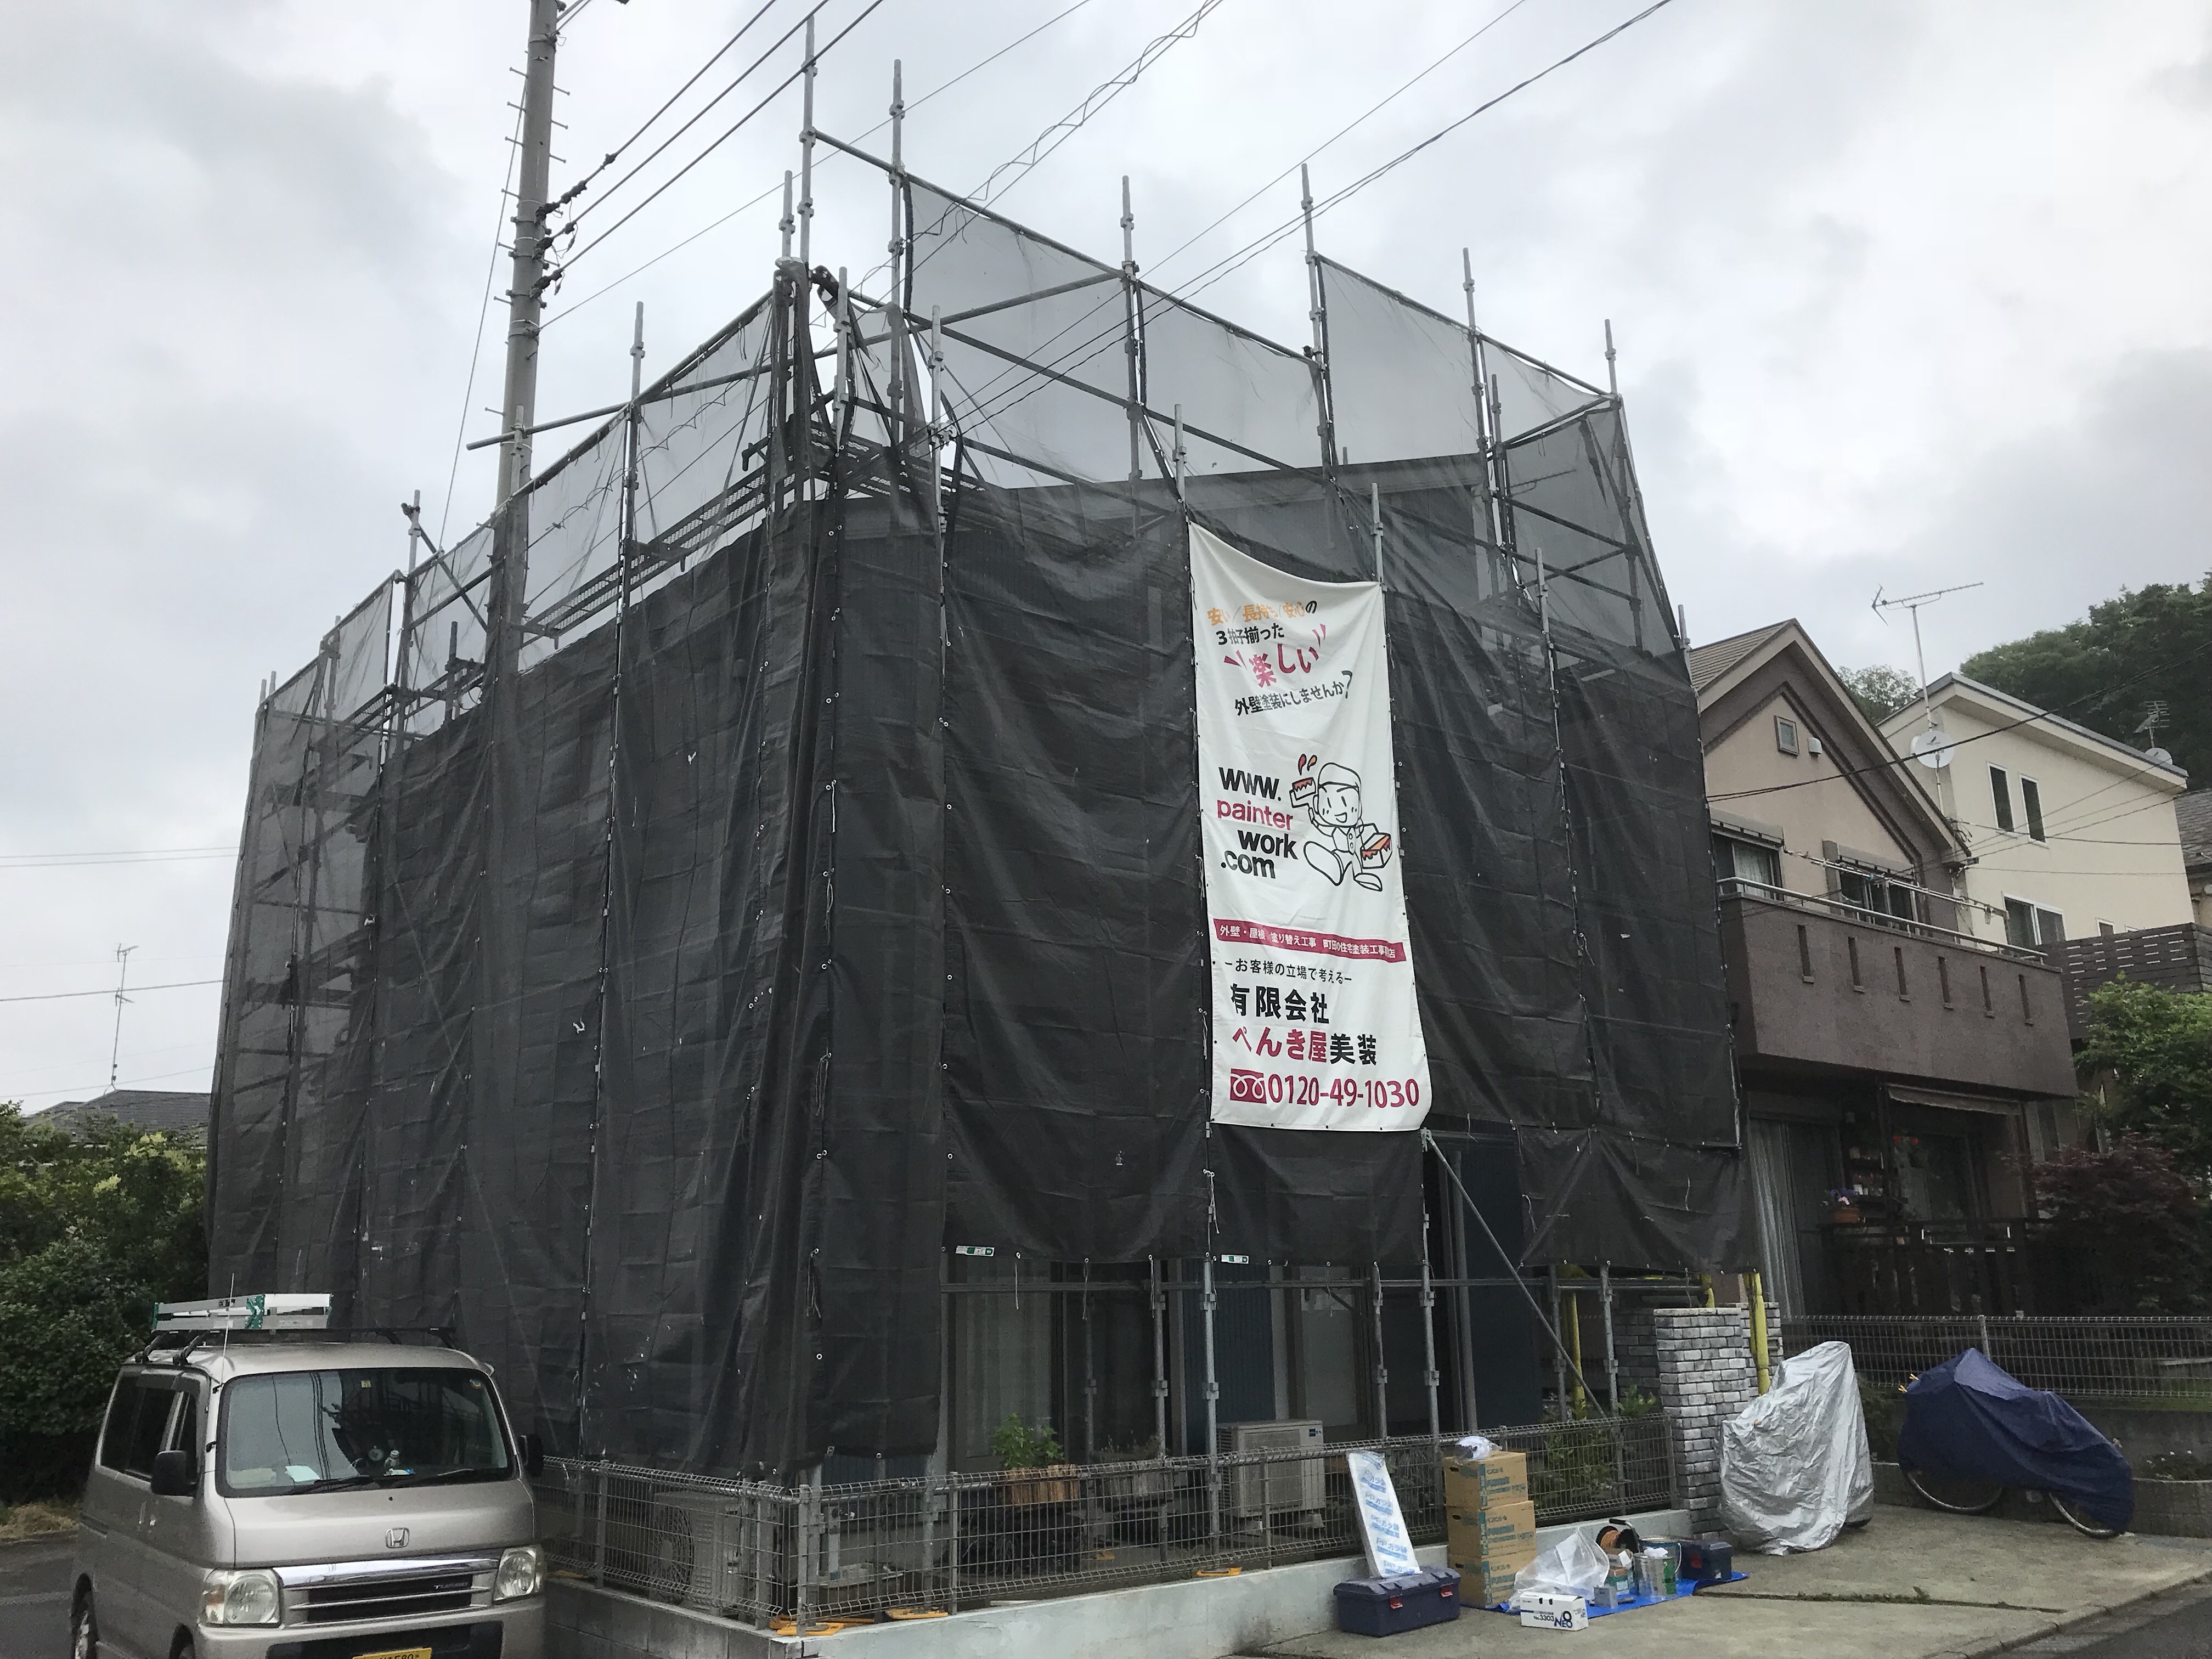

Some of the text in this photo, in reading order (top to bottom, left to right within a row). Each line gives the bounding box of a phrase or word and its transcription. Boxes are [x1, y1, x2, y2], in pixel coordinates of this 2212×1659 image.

[1249, 644, 1320, 688] 楽しい
[1218, 767, 1282, 802] www.
[1217, 799, 1294, 831] painter
[1238, 830, 1299, 860] work
[1221, 850, 1276, 879] .com
[1230, 983, 1330, 1024] 有限会社
[1232, 1026, 1377, 1065] ぺんき屋美装
[1268, 1074, 1420, 1108] 0120-49-1030
